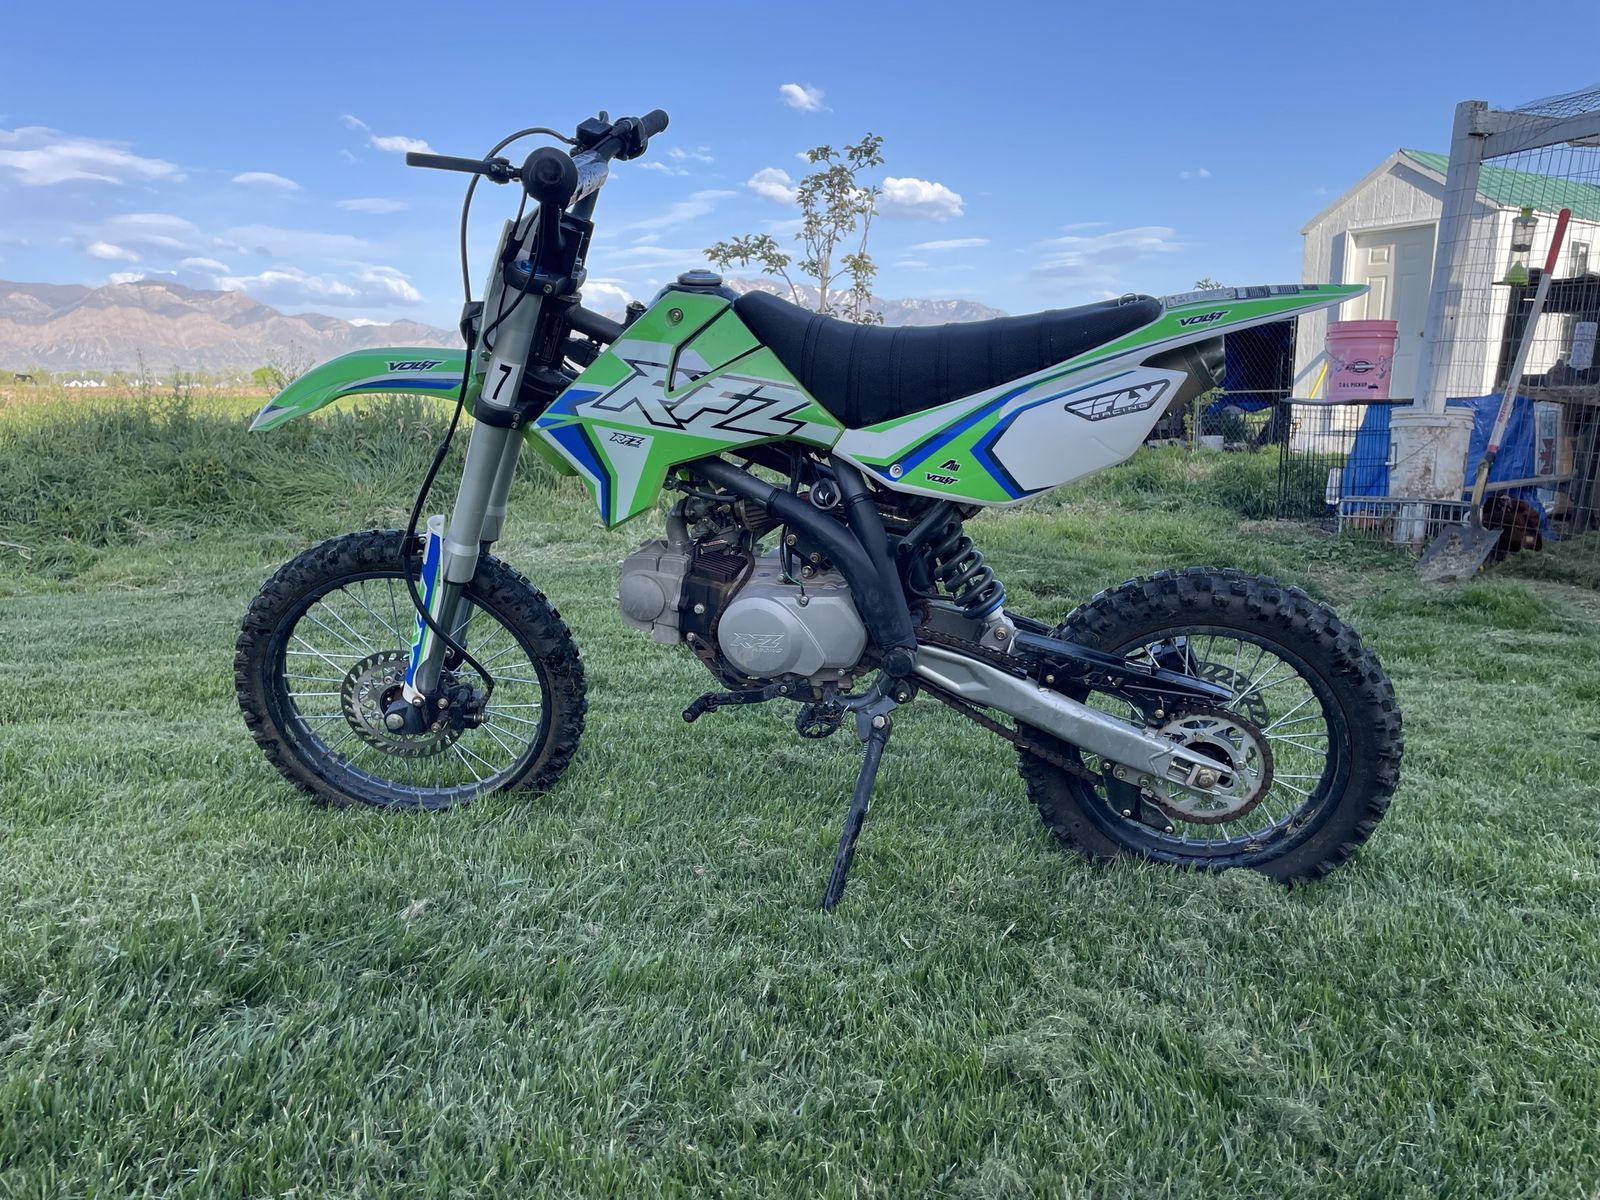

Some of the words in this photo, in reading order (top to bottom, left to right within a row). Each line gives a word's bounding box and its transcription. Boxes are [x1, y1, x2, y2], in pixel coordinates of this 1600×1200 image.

[1179, 311, 1229, 326] VOLT
[389, 360, 442, 372] VOLT
[492, 363, 513, 400] 7
[1090, 402, 1149, 420] RACING
[609, 432, 646, 446] RFZ
